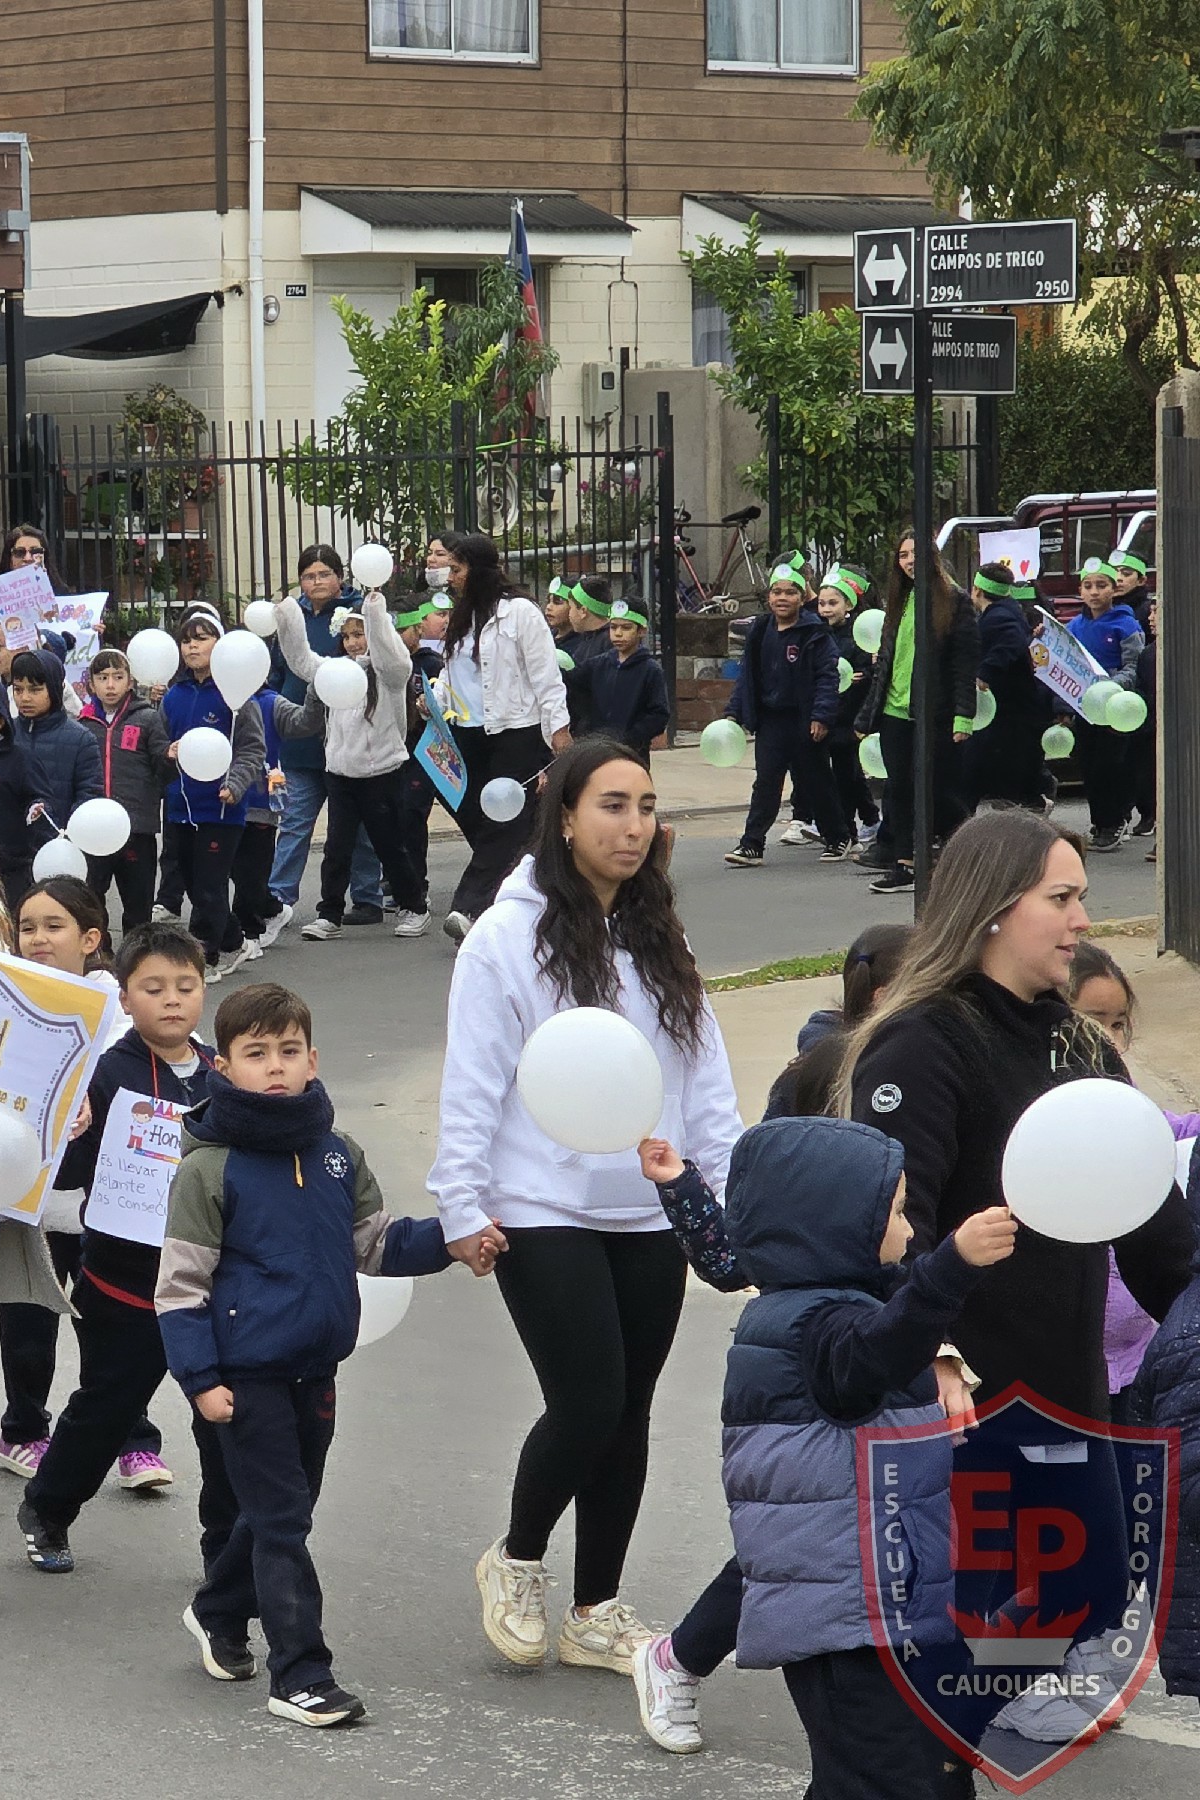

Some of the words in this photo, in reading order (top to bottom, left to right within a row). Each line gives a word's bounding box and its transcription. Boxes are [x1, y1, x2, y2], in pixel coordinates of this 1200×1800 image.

[930, 234, 968, 252] CALLE
[930, 253, 982, 271] CAMPOS
[985, 252, 1003, 269] DE
[1006, 250, 1045, 267] TRIGO
[930, 286, 963, 302] 2994
[1035, 280, 1069, 297] 2950
[932, 322, 952, 338] ALLE
[932, 342, 962, 358] AMPOS
[964, 342, 974, 358] DE
[976, 342, 1000, 358] TRIGO
[13, 1095, 28, 1112] es
[149, 1124, 181, 1149] Hon
